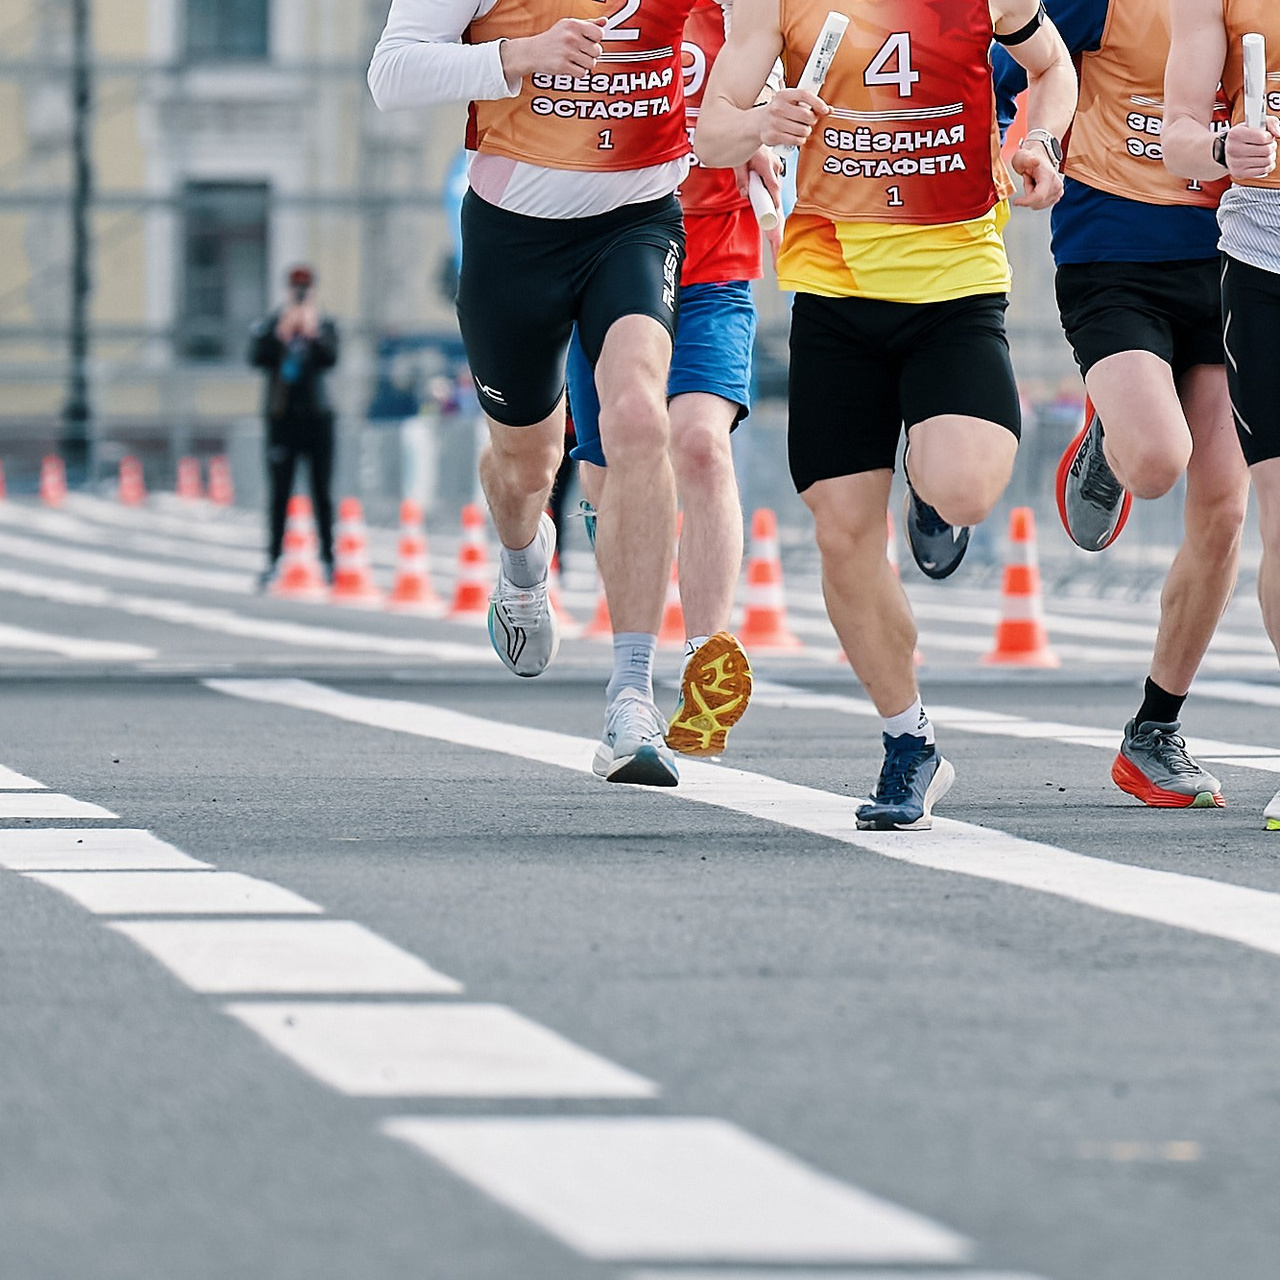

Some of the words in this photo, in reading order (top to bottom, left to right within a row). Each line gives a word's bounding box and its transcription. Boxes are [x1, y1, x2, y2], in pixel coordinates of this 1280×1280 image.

[863, 31, 920, 98] 4
[531, 96, 672, 119] ЭСТАФЕТА
[598, 128, 614, 149] 1
[824, 124, 966, 154] ЗВЁЗДНАЯ
[823, 152, 967, 178] ЭСТАФЕТА
[886, 186, 904, 207] 1
